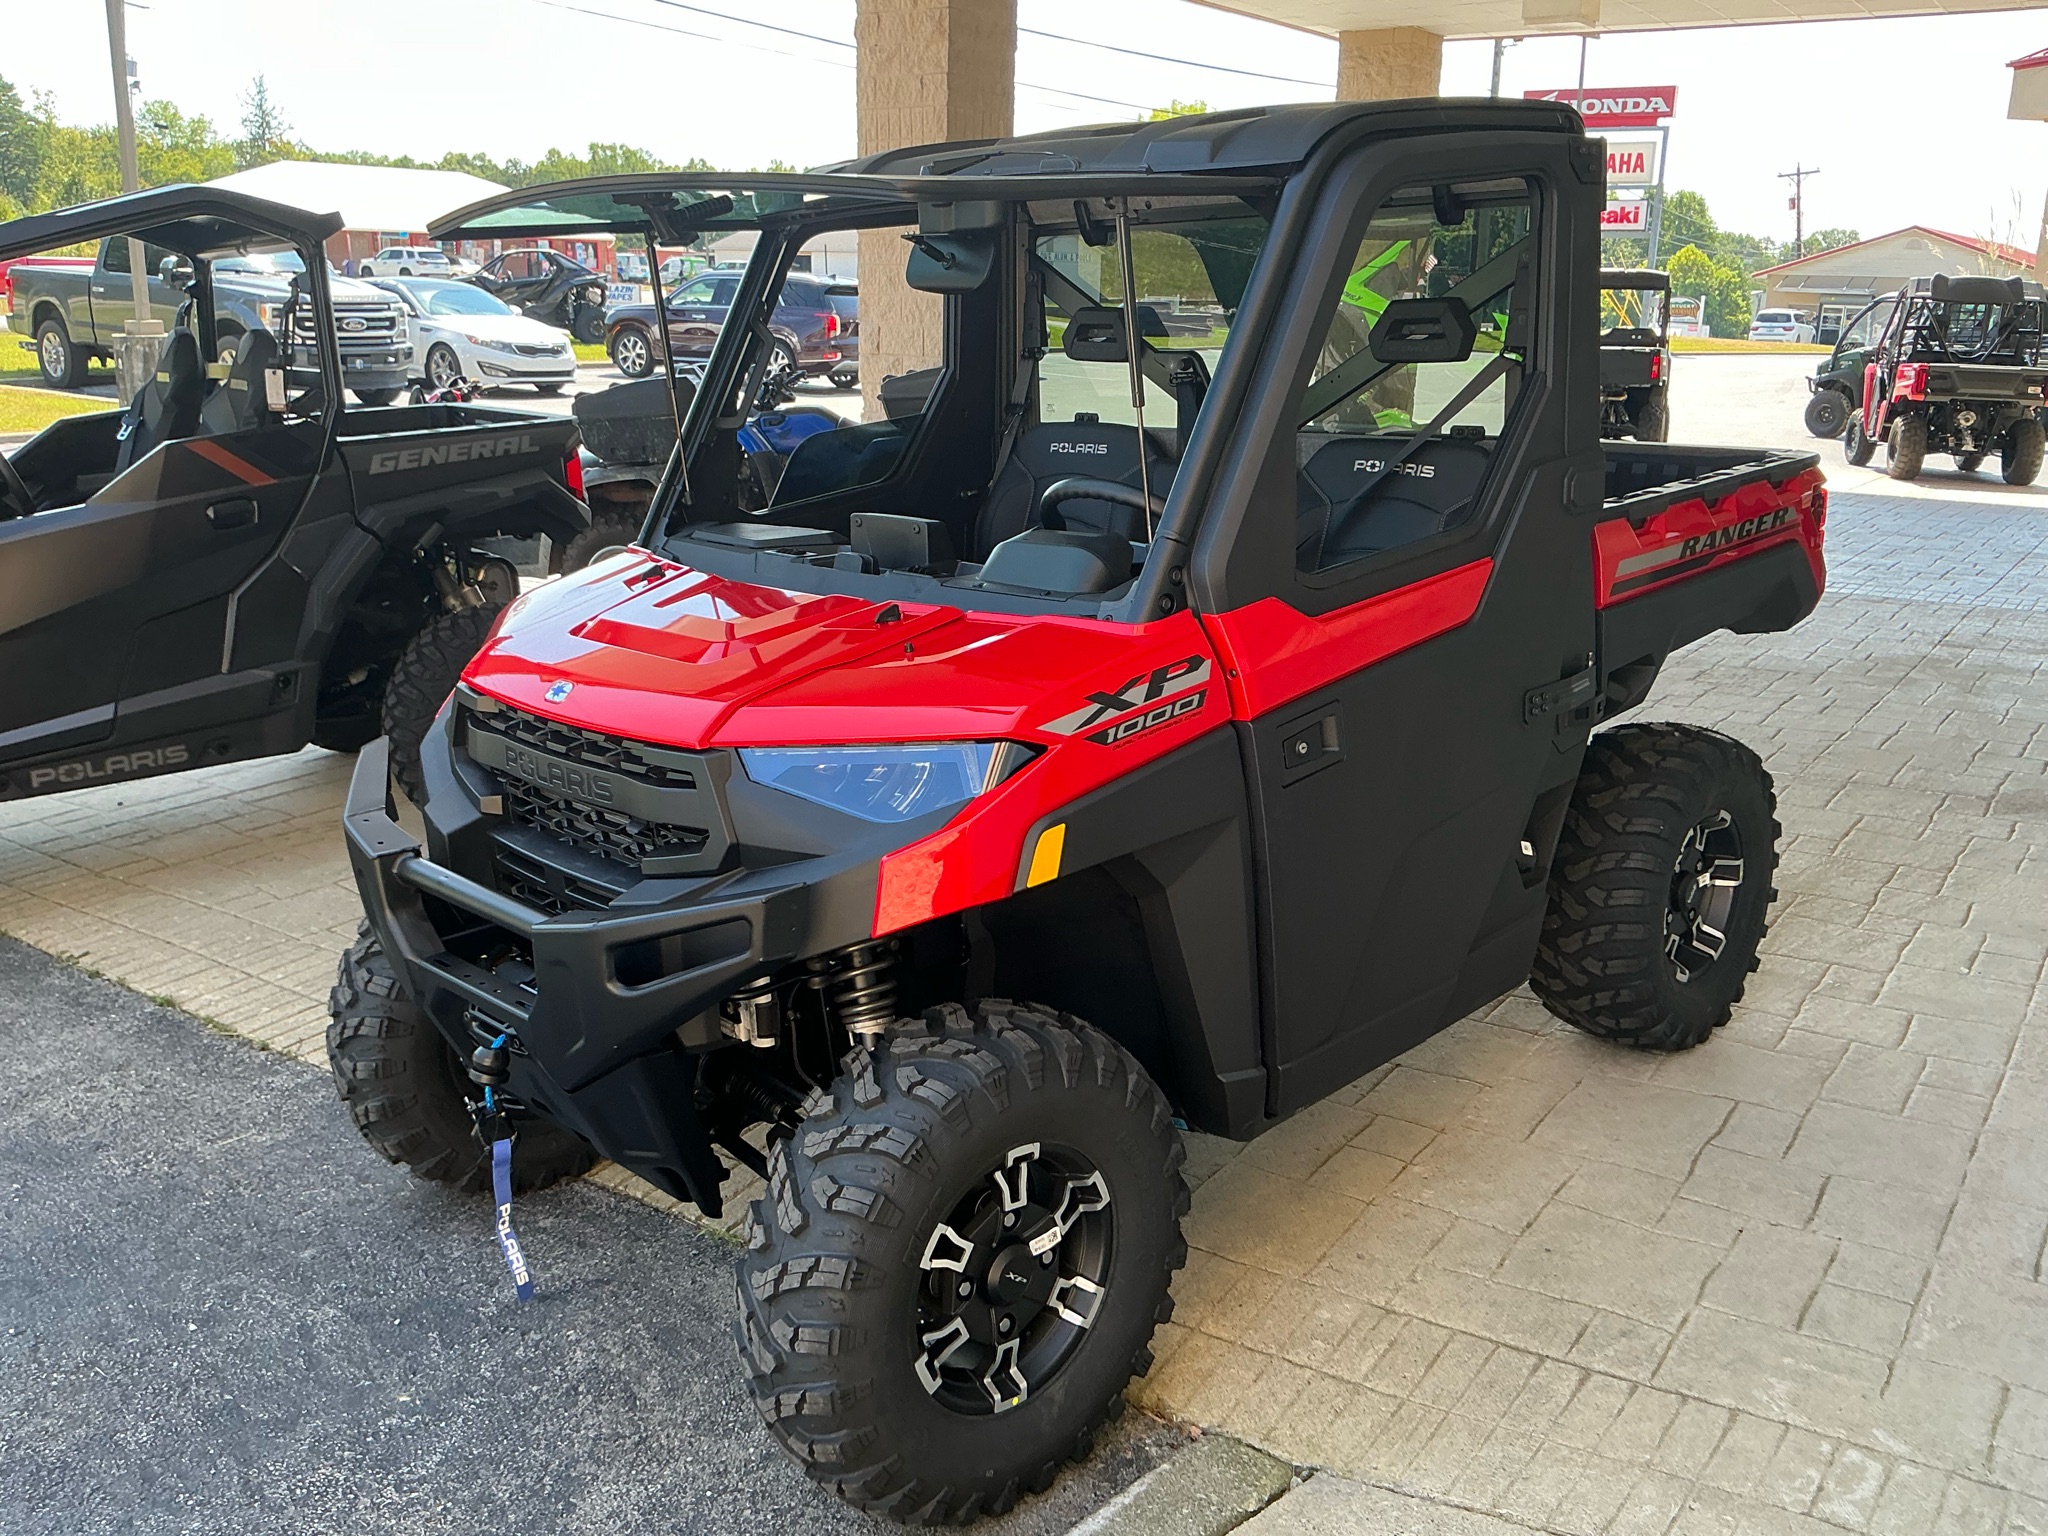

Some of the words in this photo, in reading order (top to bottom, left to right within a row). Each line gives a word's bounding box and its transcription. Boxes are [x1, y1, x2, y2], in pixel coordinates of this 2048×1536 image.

[1606, 153, 1645, 173] AHA
[1600, 206, 1640, 224] saki
[608, 285, 636, 293] LAZIN'
[369, 435, 540, 475] GENERAL
[1050, 442, 1108, 455] POLARIS
[1679, 507, 1789, 561] RANGER
[1073, 653, 1206, 734] XP
[1106, 694, 1200, 744] 1000
[29, 744, 189, 788] POLARIS
[504, 748, 614, 804] POLARIS
[499, 1202, 530, 1286] POLARIS
